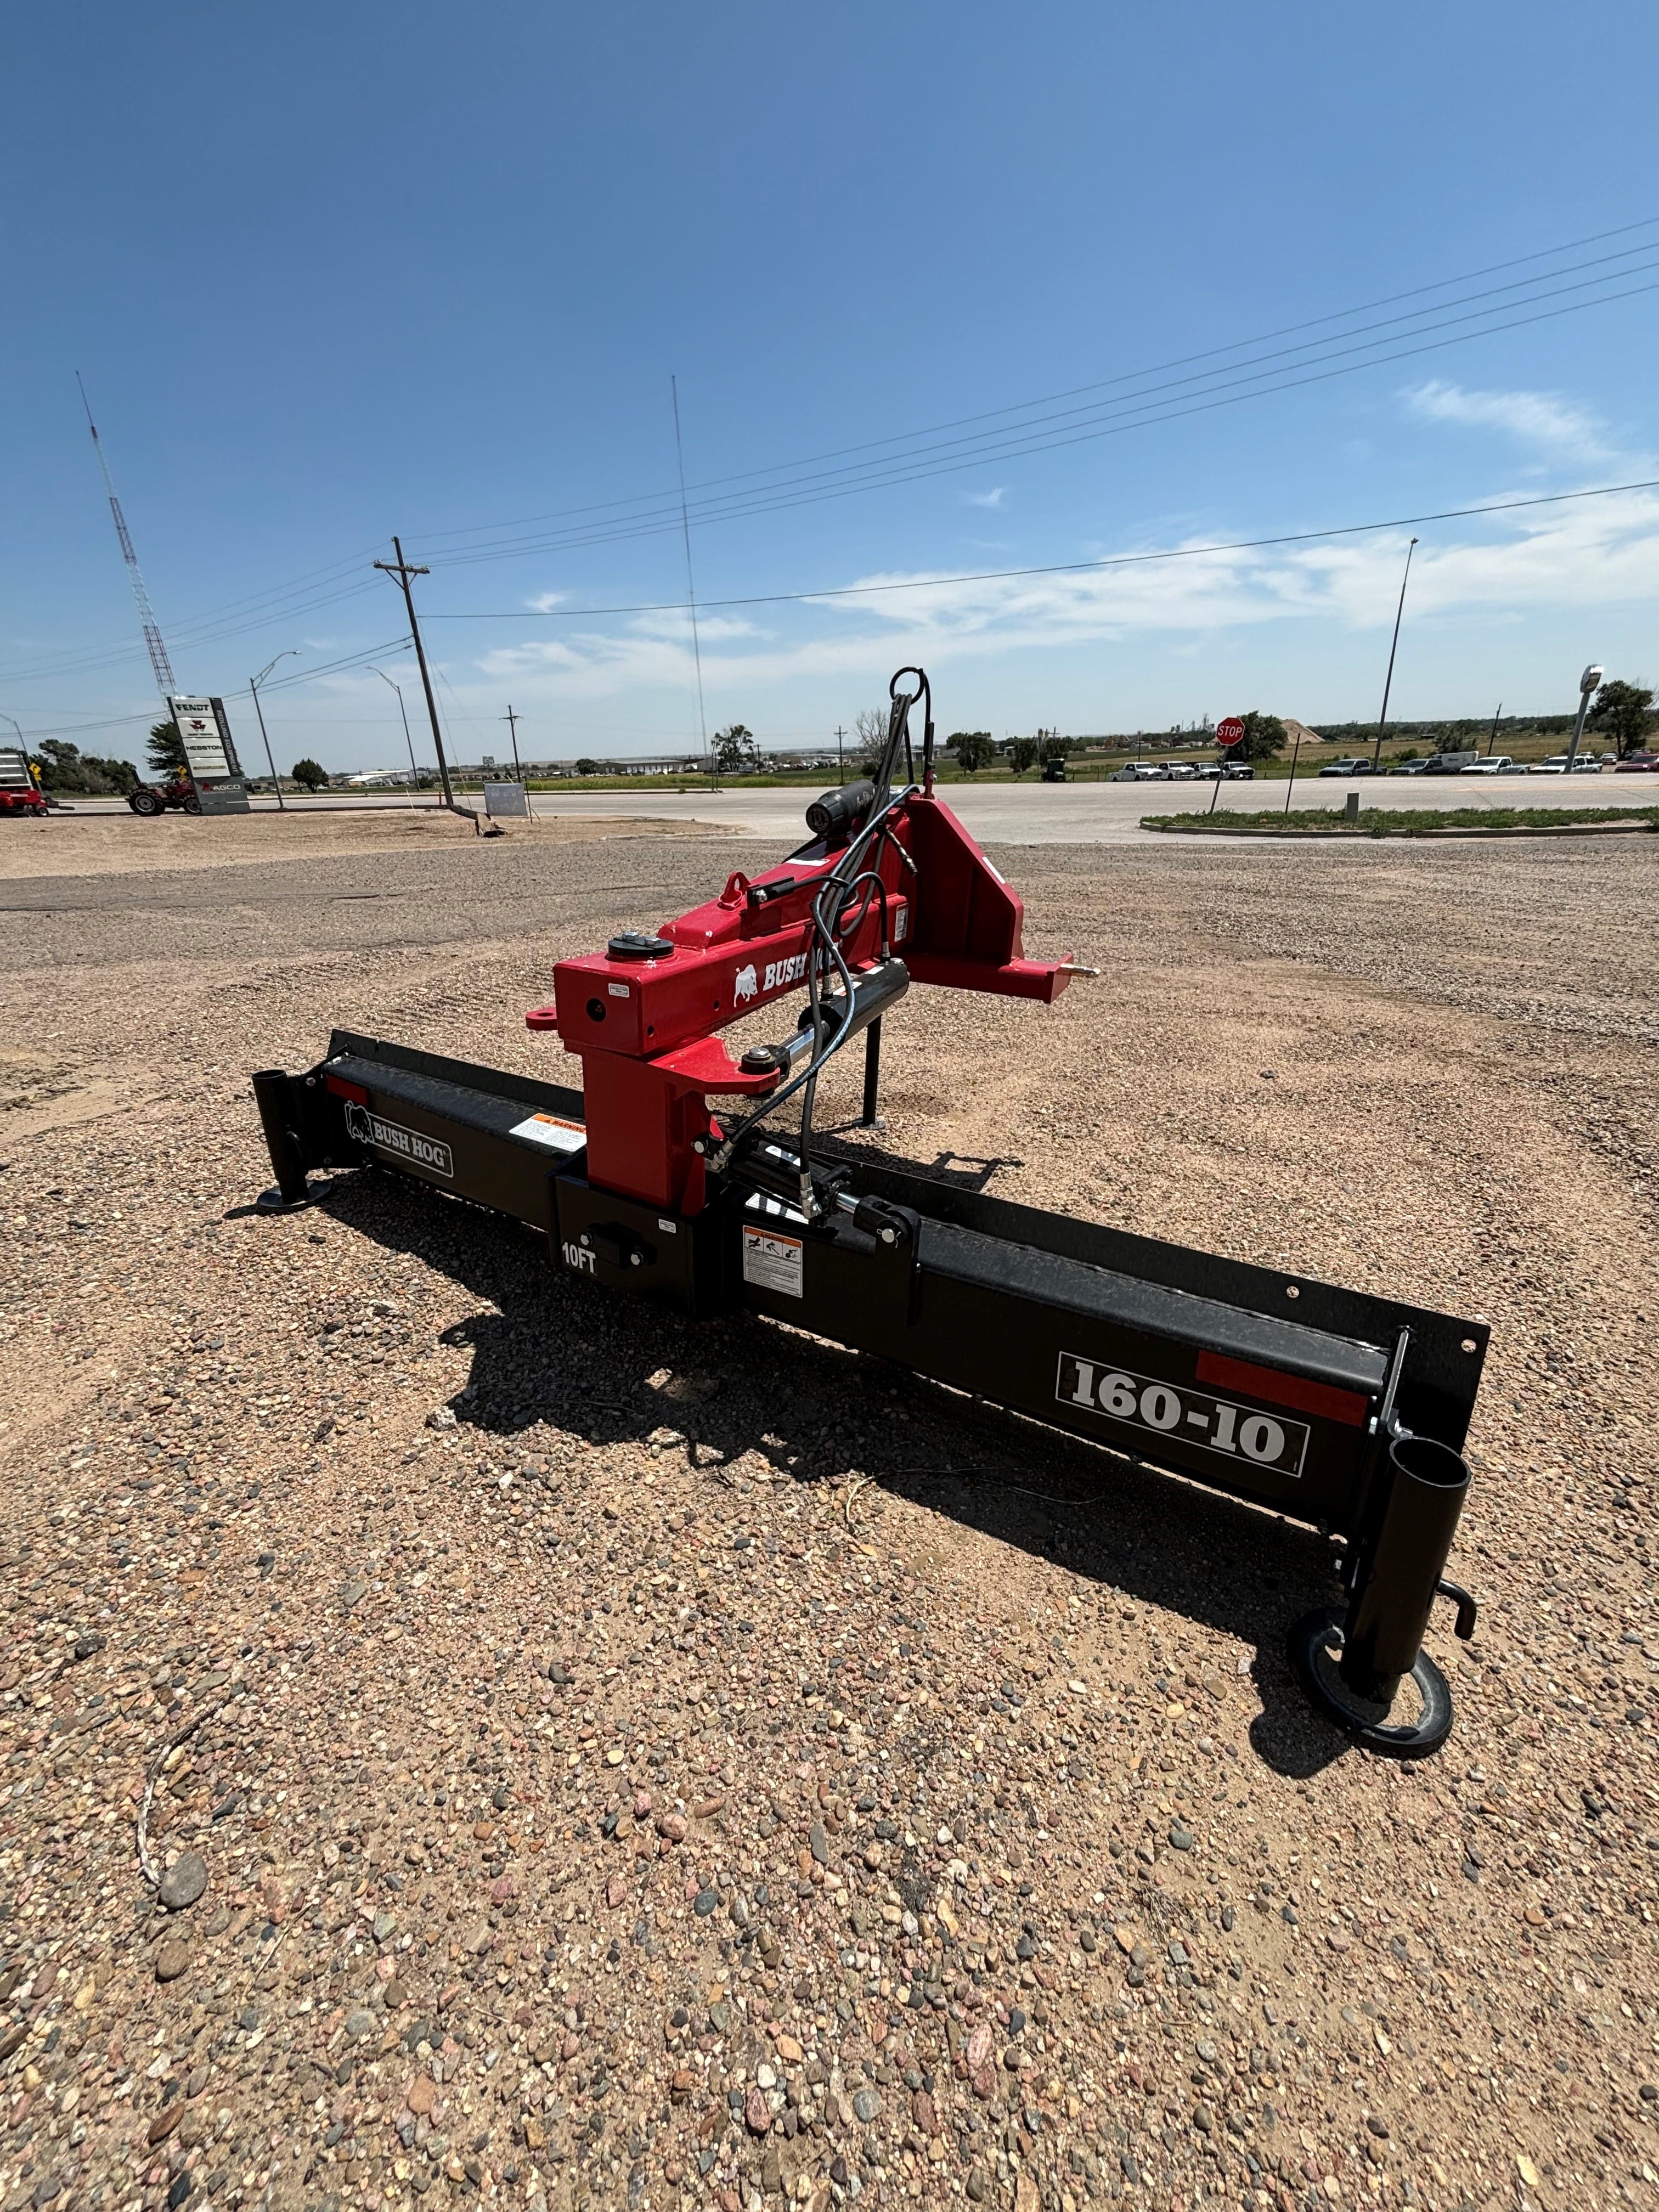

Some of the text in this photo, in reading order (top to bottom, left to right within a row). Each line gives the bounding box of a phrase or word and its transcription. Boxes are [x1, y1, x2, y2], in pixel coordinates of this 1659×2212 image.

[216, 710, 239, 772] REDLUND EQUIPMENT
[1218, 725, 1243, 737] STOP
[763, 952, 807, 991] BUSH
[373, 1121, 410, 1153] BUSH
[552, 1120, 586, 1132] WARNING
[562, 1242, 596, 1273] 10FT
[1072, 1361, 1285, 1462] 160-10
